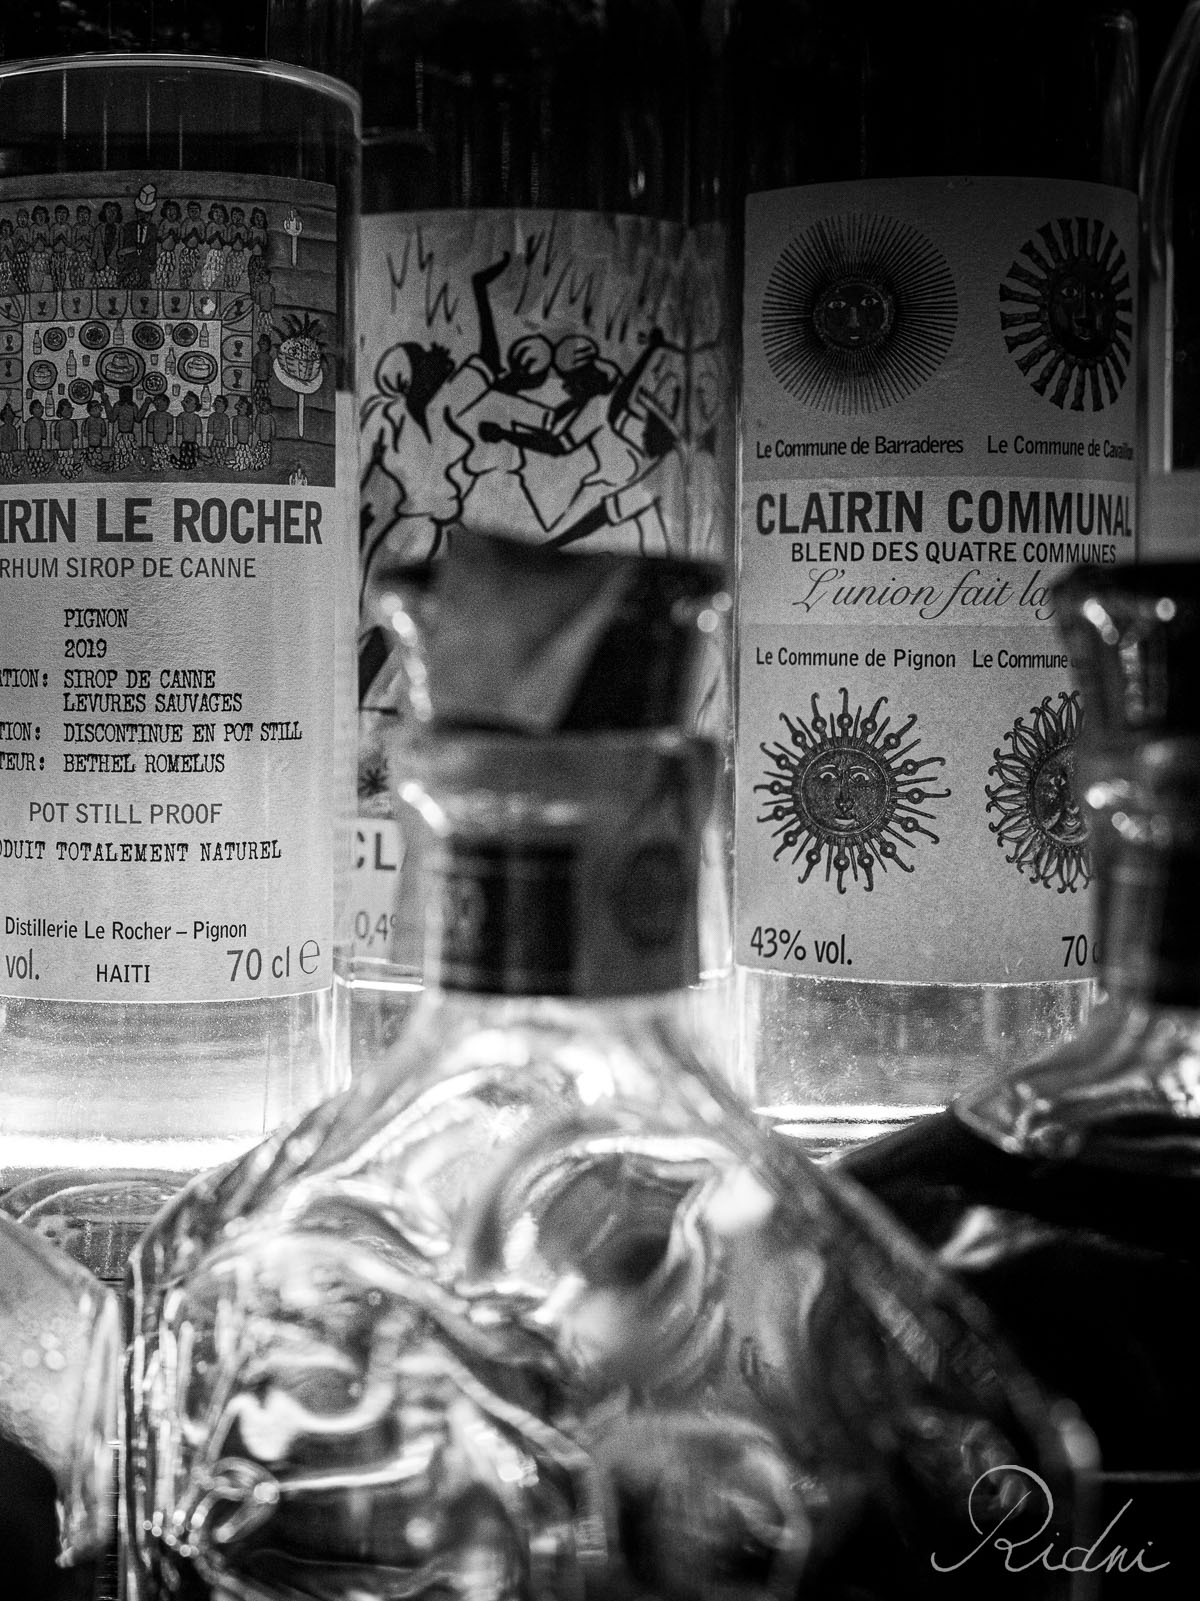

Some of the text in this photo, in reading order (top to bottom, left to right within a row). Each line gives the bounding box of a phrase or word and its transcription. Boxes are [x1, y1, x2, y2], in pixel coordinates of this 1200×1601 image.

[756, 435, 964, 458] Le Commune de Barraderes
[987, 435, 1008, 453] Le
[1013, 435, 1084, 456] Commune
[1088, 438, 1100, 457] de
[96, 497, 153, 543] LE
[173, 497, 323, 544] ROCHER
[756, 490, 1132, 537] CLAIRIN COMMUNAL
[791, 541, 1116, 564] BLEND DES QUATRE COMMUNES
[0, 557, 256, 579] RHUM SIROP DE CANNE
[940, 569, 1018, 617] fait
[64, 608, 129, 628] PIGNON
[64, 639, 107, 658] 2019
[756, 647, 956, 670] Le Commune de Pignon
[973, 650, 993, 668] Le
[997, 651, 1068, 669] Commune
[63, 669, 118, 689] SIROP
[126, 670, 151, 688] DE
[159, 669, 216, 689] CANNE
[63, 693, 243, 712] LEVURES SAUVAGES
[63, 723, 183, 743] DISCONTINUE
[192, 723, 215, 742] EN
[224, 722, 253, 742] POT
[260, 721, 302, 741] STILL
[63, 753, 136, 773] BETHEL
[144, 754, 225, 773] ROMELUS
[29, 802, 222, 824] POT STILL PROOF
[56, 842, 188, 862] TOTALEMENT
[200, 839, 282, 862] NATUREL
[5, 916, 78, 938] Distillerie
[84, 921, 105, 939] Le
[111, 922, 172, 941] Rocher
[193, 921, 247, 943] Pignon
[750, 925, 853, 966] 43% vol.
[1061, 935, 1088, 967] 70
[6, 949, 40, 980] vol.
[96, 964, 150, 983] HAITI
[226, 948, 262, 982] 70
[271, 945, 290, 978] cl
